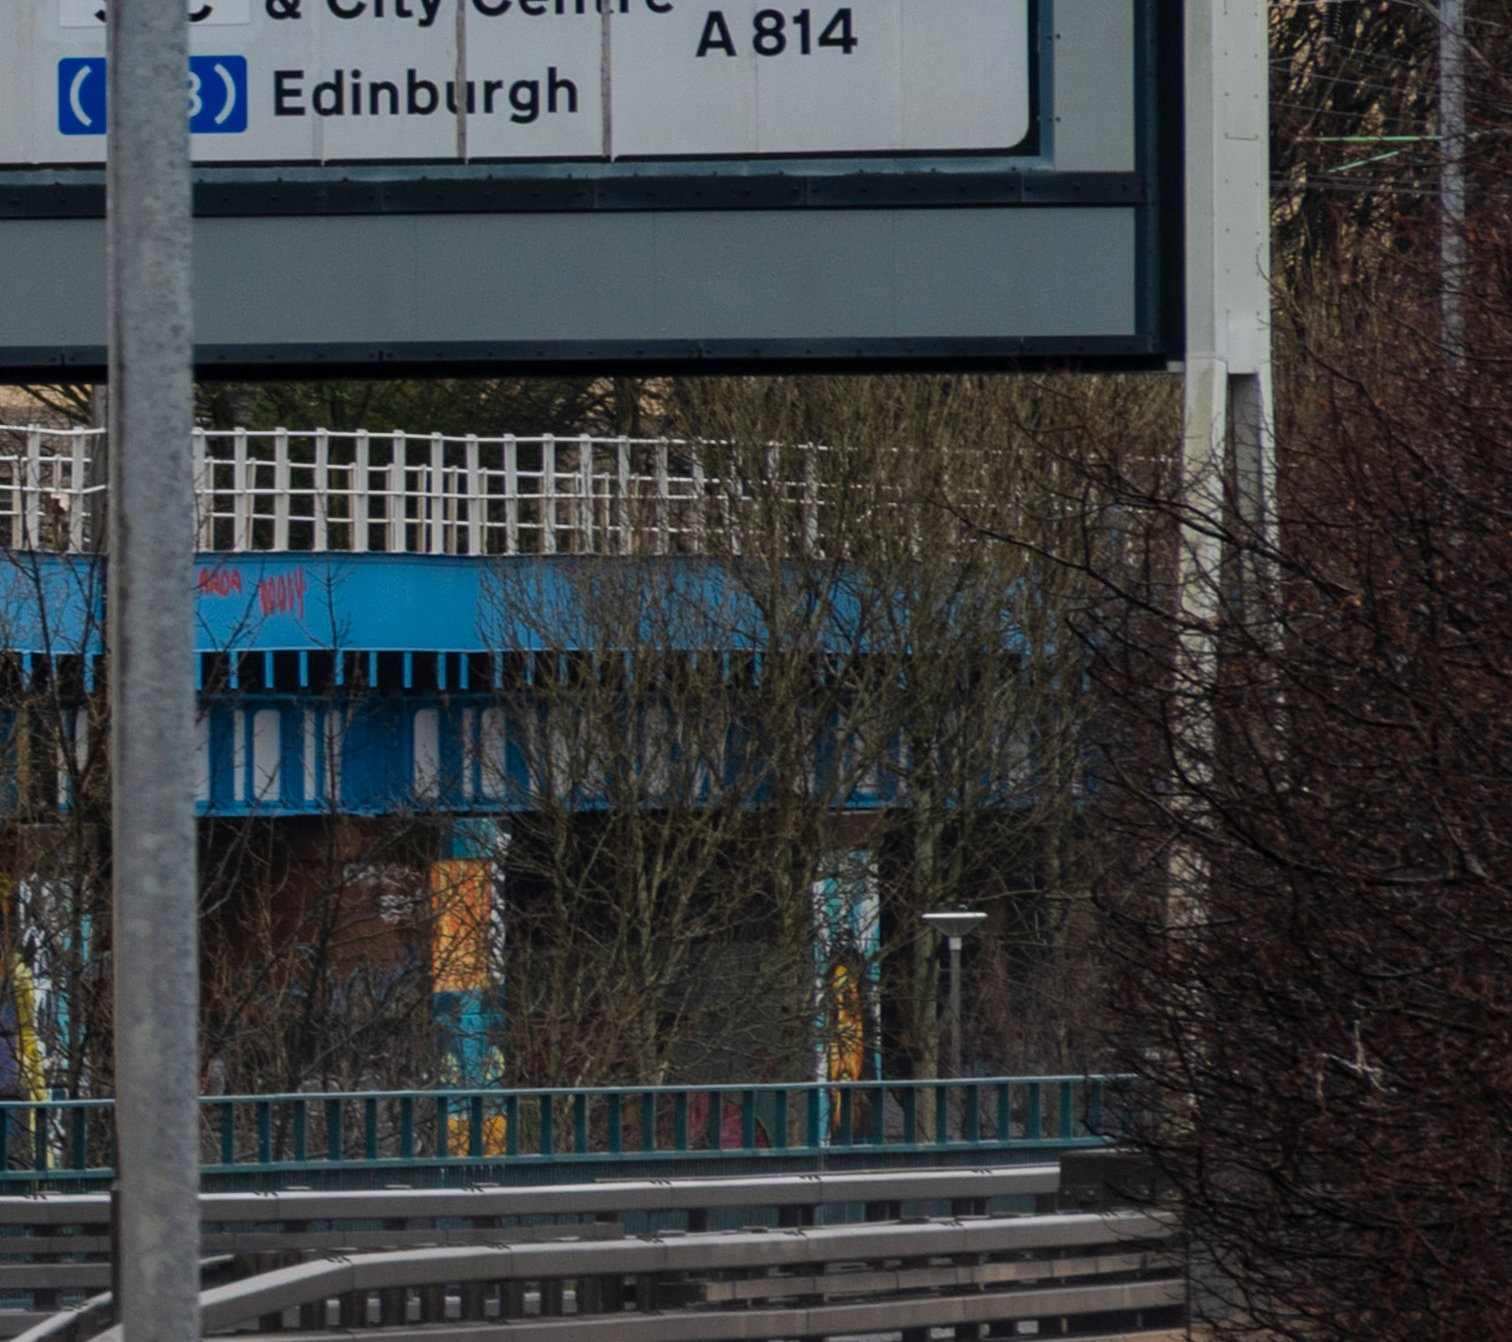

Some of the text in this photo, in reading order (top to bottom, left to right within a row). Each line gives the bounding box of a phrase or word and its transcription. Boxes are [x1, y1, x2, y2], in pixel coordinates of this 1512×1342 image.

[695, 7, 858, 58] A 814
[273, 66, 578, 124] Edinburgh
